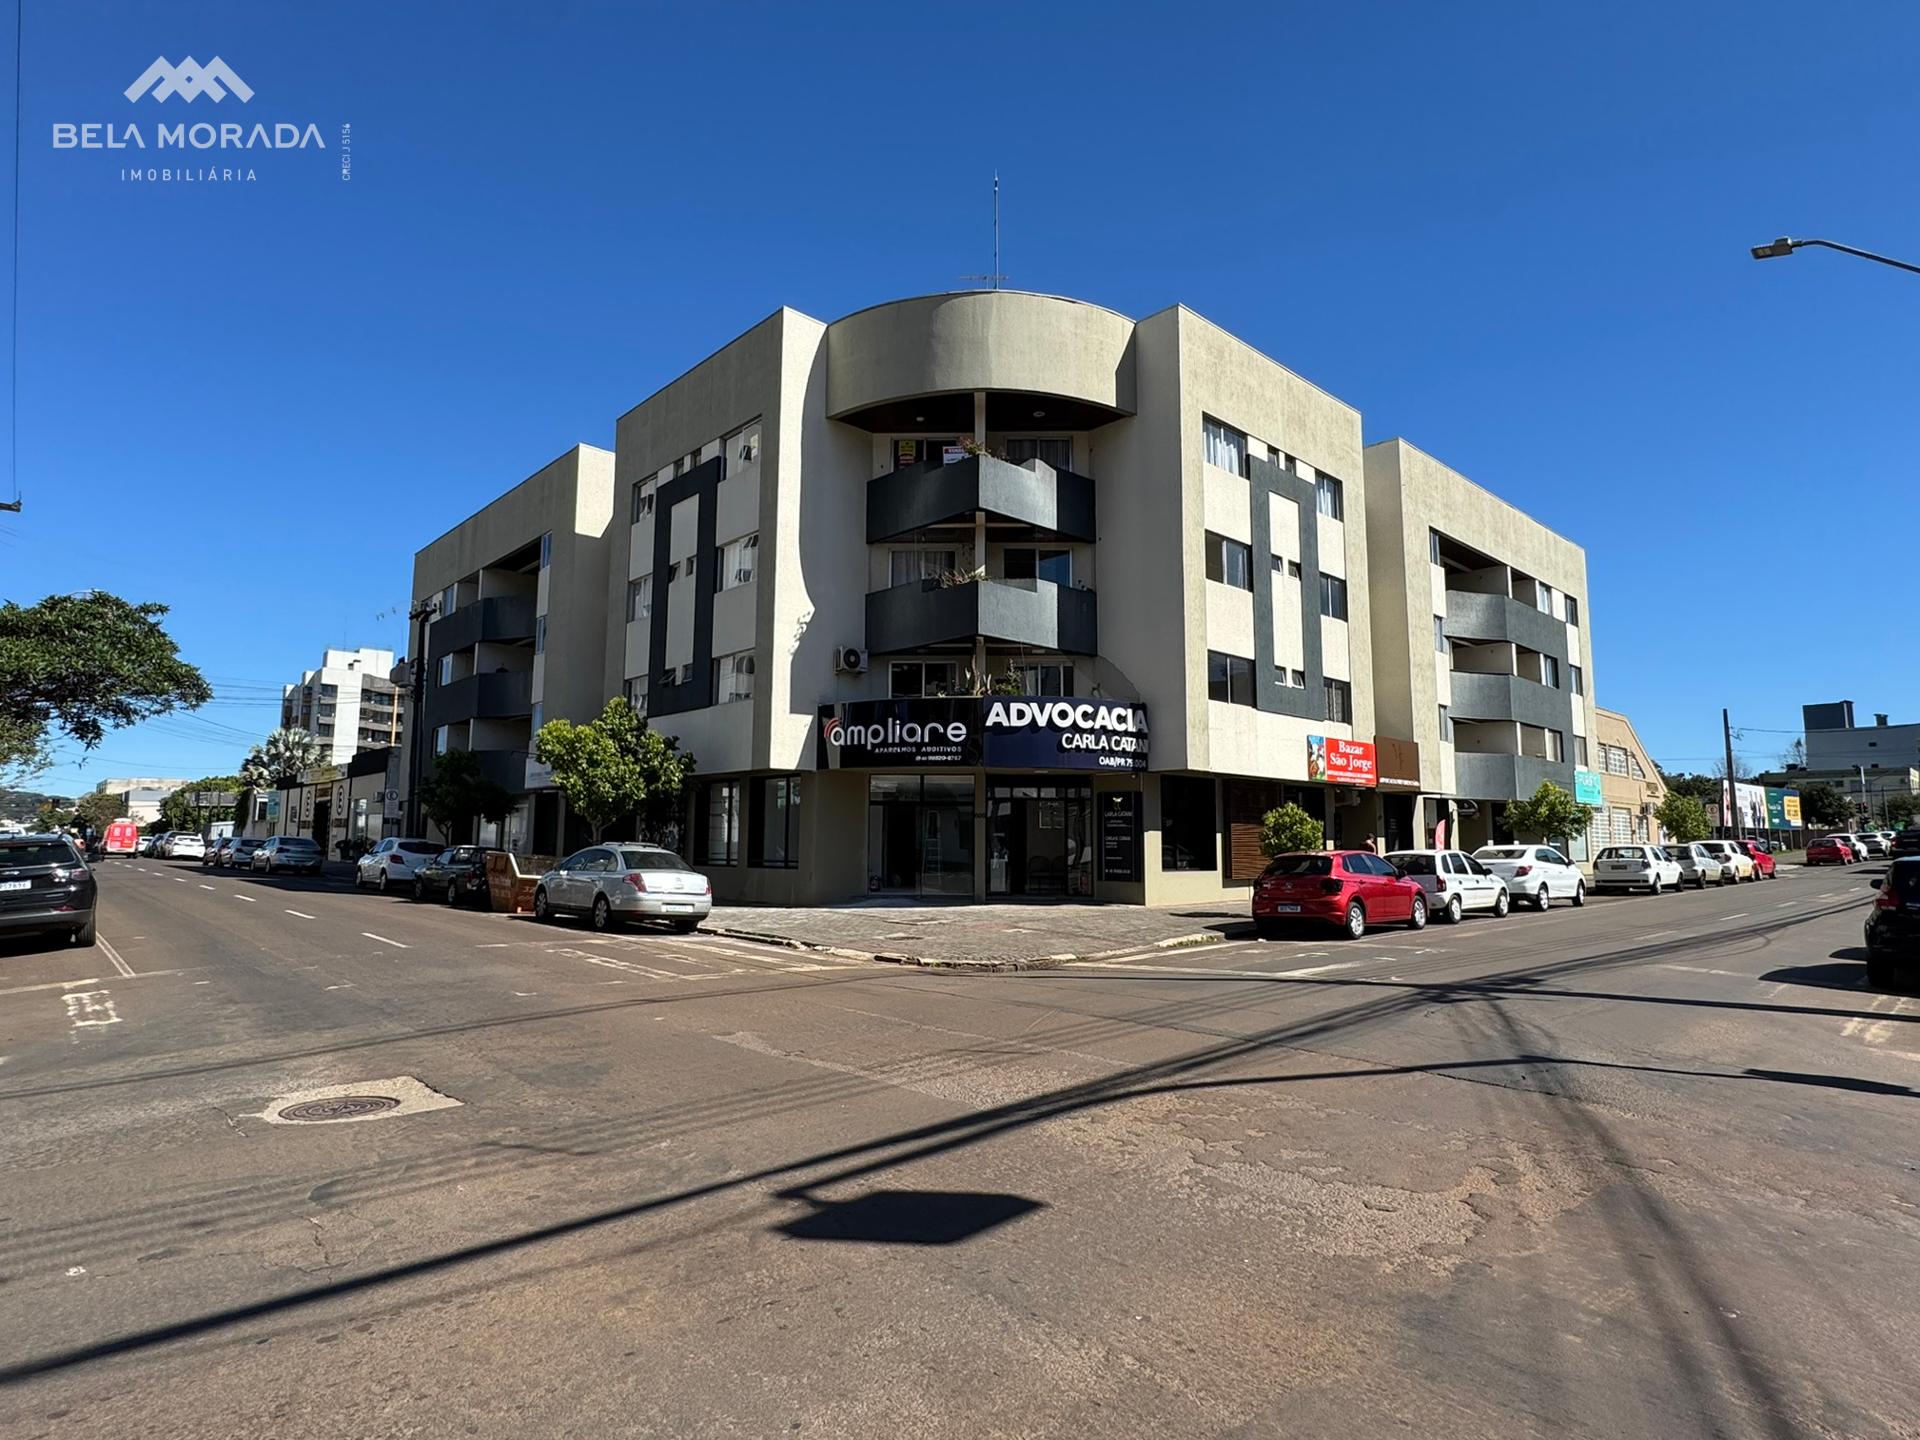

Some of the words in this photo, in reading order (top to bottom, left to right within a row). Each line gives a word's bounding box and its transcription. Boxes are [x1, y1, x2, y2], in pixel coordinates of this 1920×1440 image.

[985, 702, 1148, 732] ADVOCACIA
[829, 717, 967, 750] ampliare
[1061, 732, 1109, 750] CARLA
[1338, 740, 1364, 755] Bazar
[1330, 752, 1347, 766] São
[1348, 755, 1373, 772] Jorge
